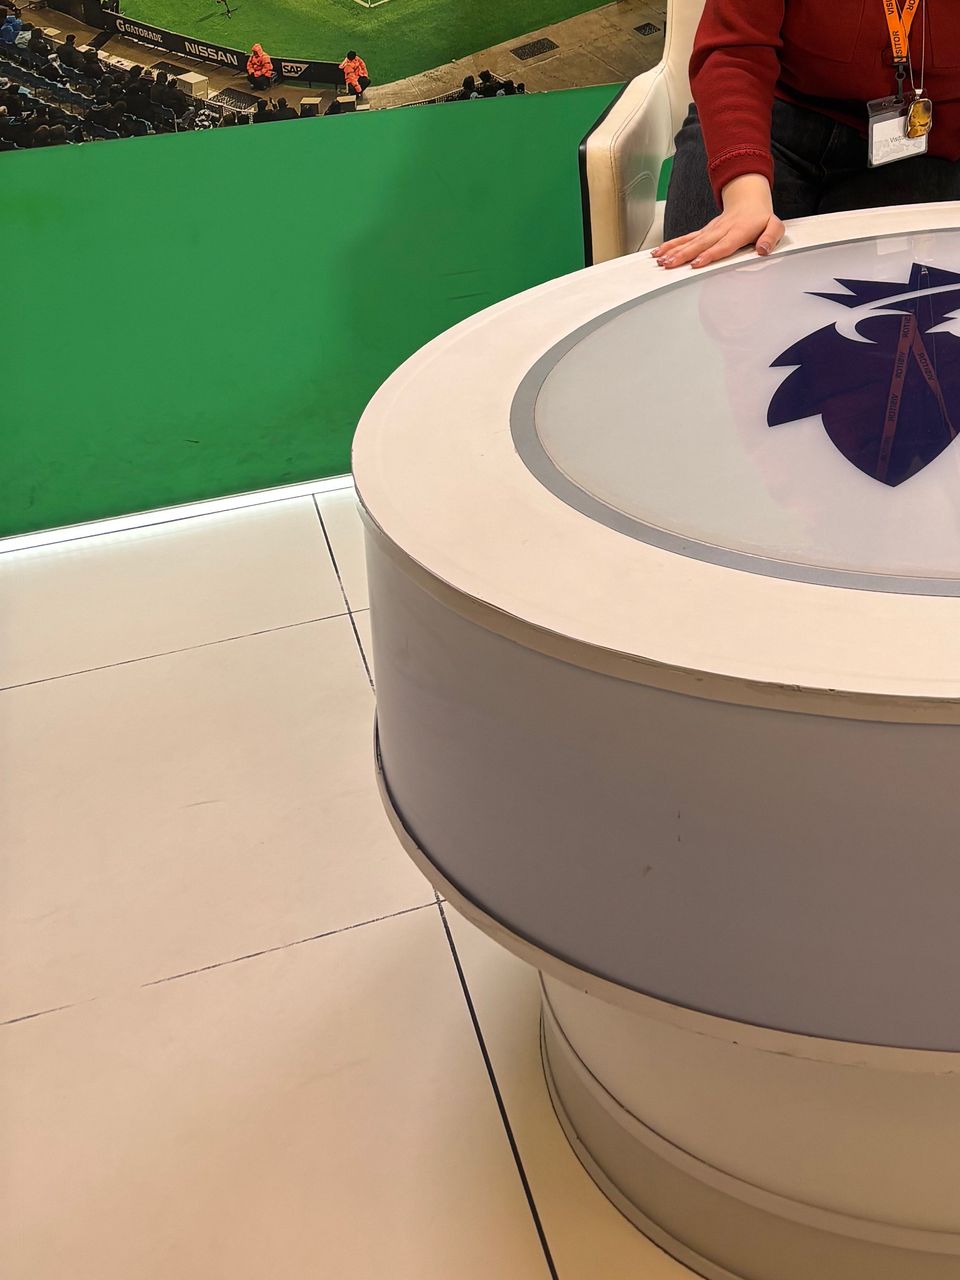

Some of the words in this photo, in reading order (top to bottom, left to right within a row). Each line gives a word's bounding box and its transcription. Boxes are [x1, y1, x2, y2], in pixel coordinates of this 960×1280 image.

[125, 24, 163, 43] GATORADE
[185, 41, 239, 66] NISSAN
[282, 63, 303, 75] SAP
